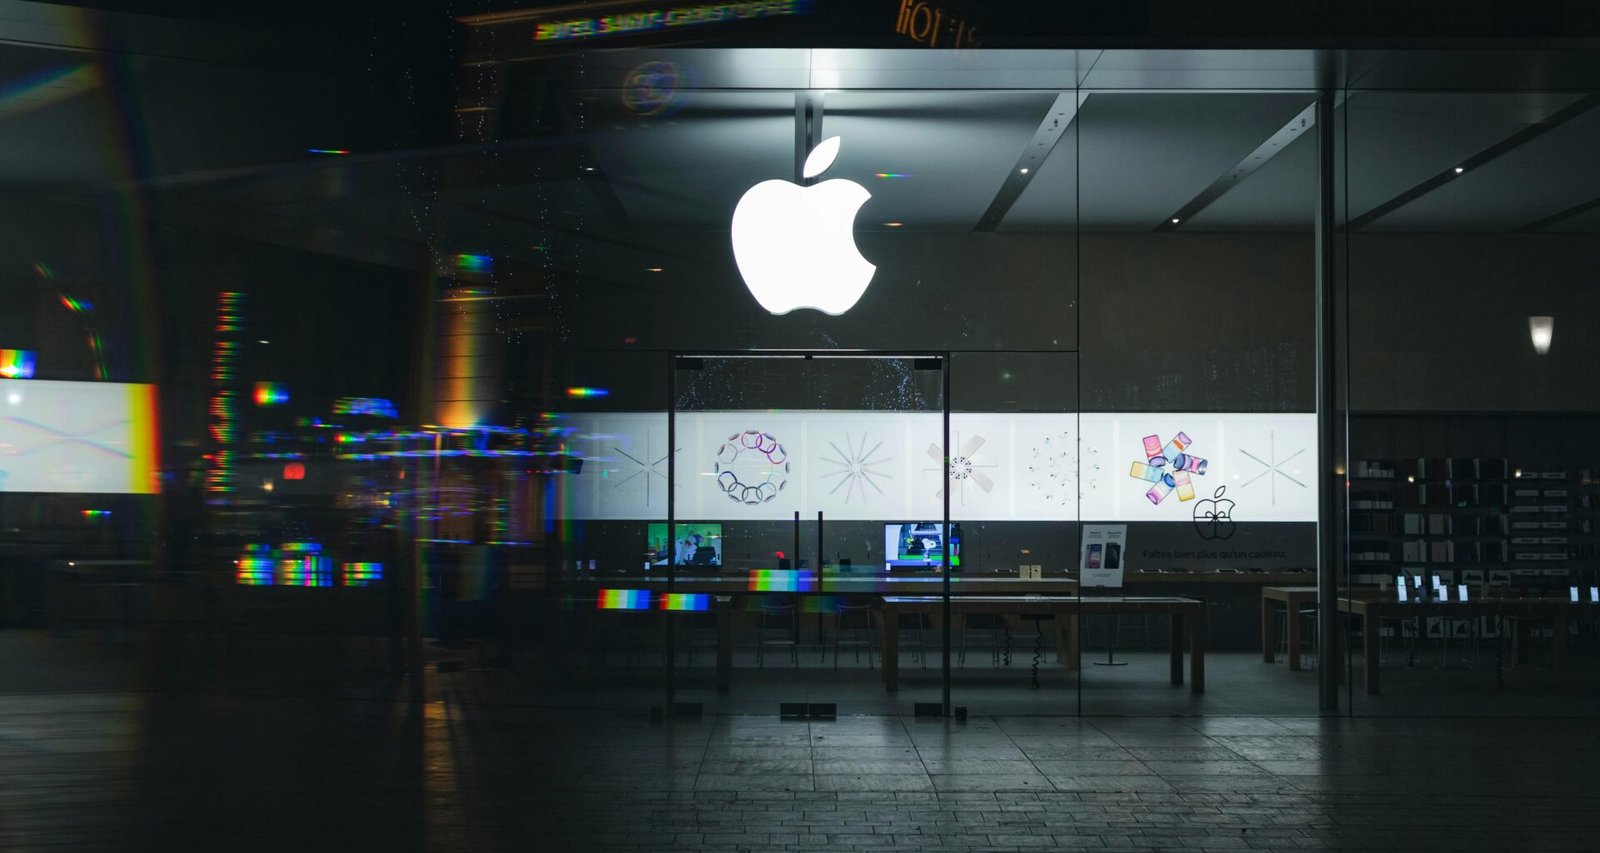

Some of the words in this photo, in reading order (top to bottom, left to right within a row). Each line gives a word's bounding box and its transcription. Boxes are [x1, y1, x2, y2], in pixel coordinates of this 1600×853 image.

[1143, 549, 1172, 559] Faites
[1174, 549, 1195, 559] bien
[1198, 549, 1218, 561] plus
